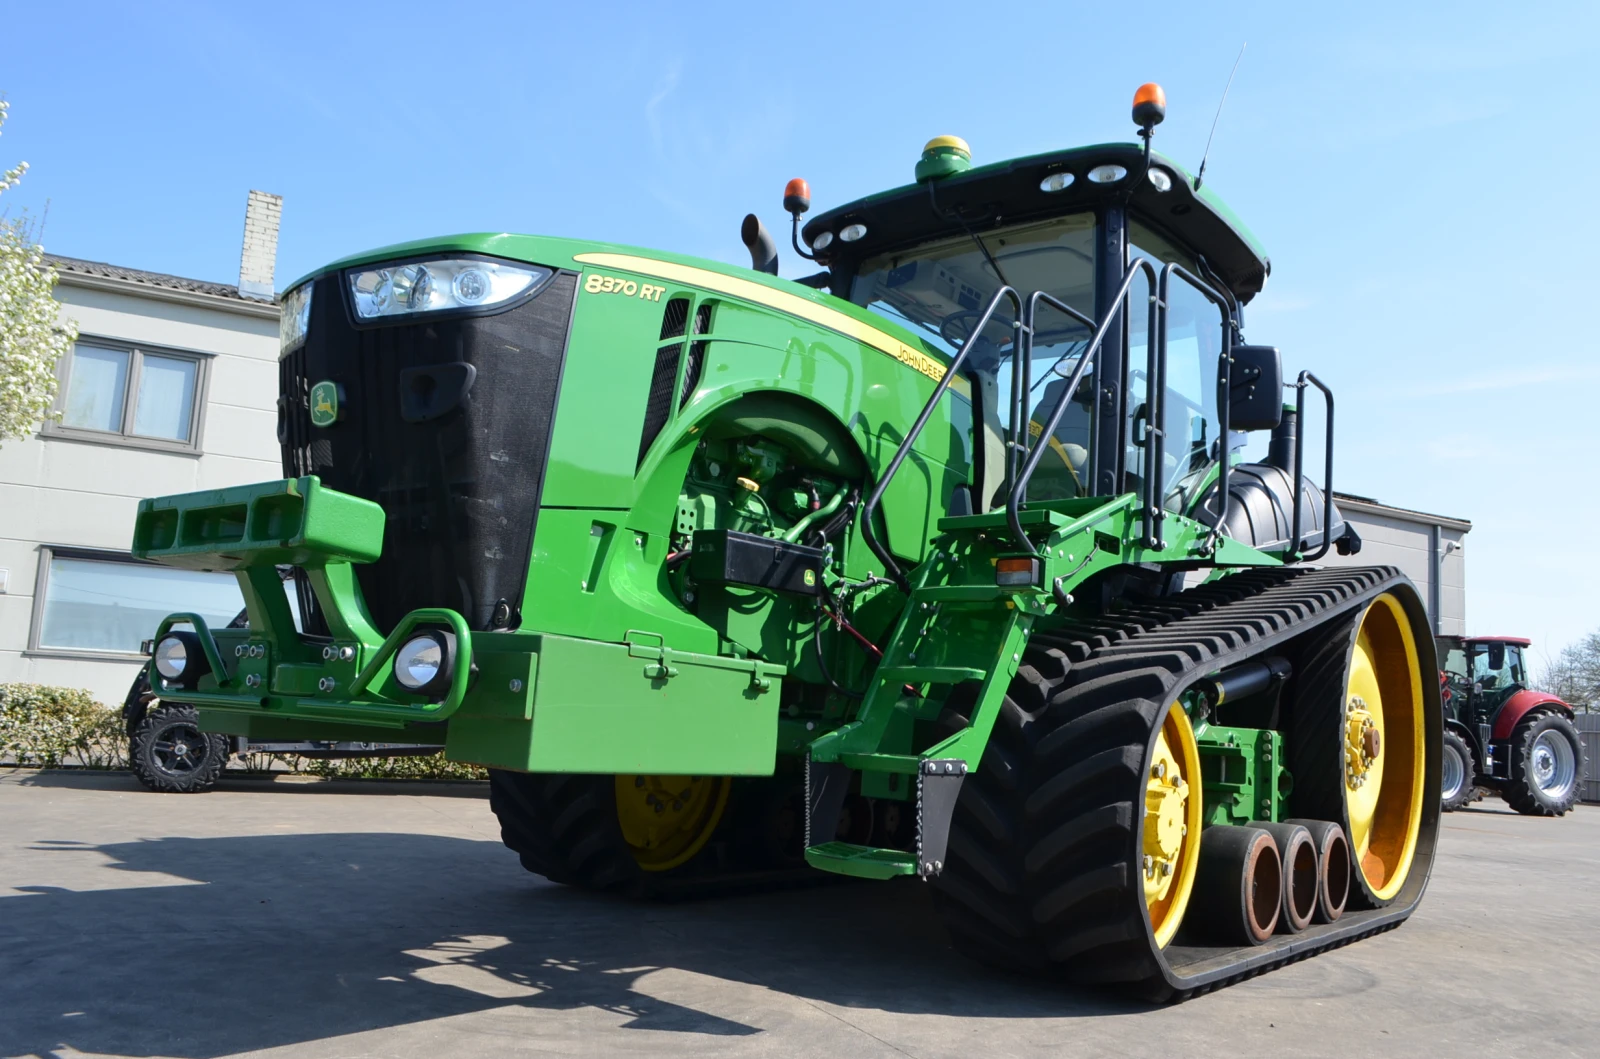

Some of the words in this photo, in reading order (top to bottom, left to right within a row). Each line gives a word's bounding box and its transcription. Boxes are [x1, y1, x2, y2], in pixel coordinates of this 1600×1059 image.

[584, 274, 638, 296] 8370
[640, 283, 666, 302] RT
[921, 357, 943, 379] DEER
